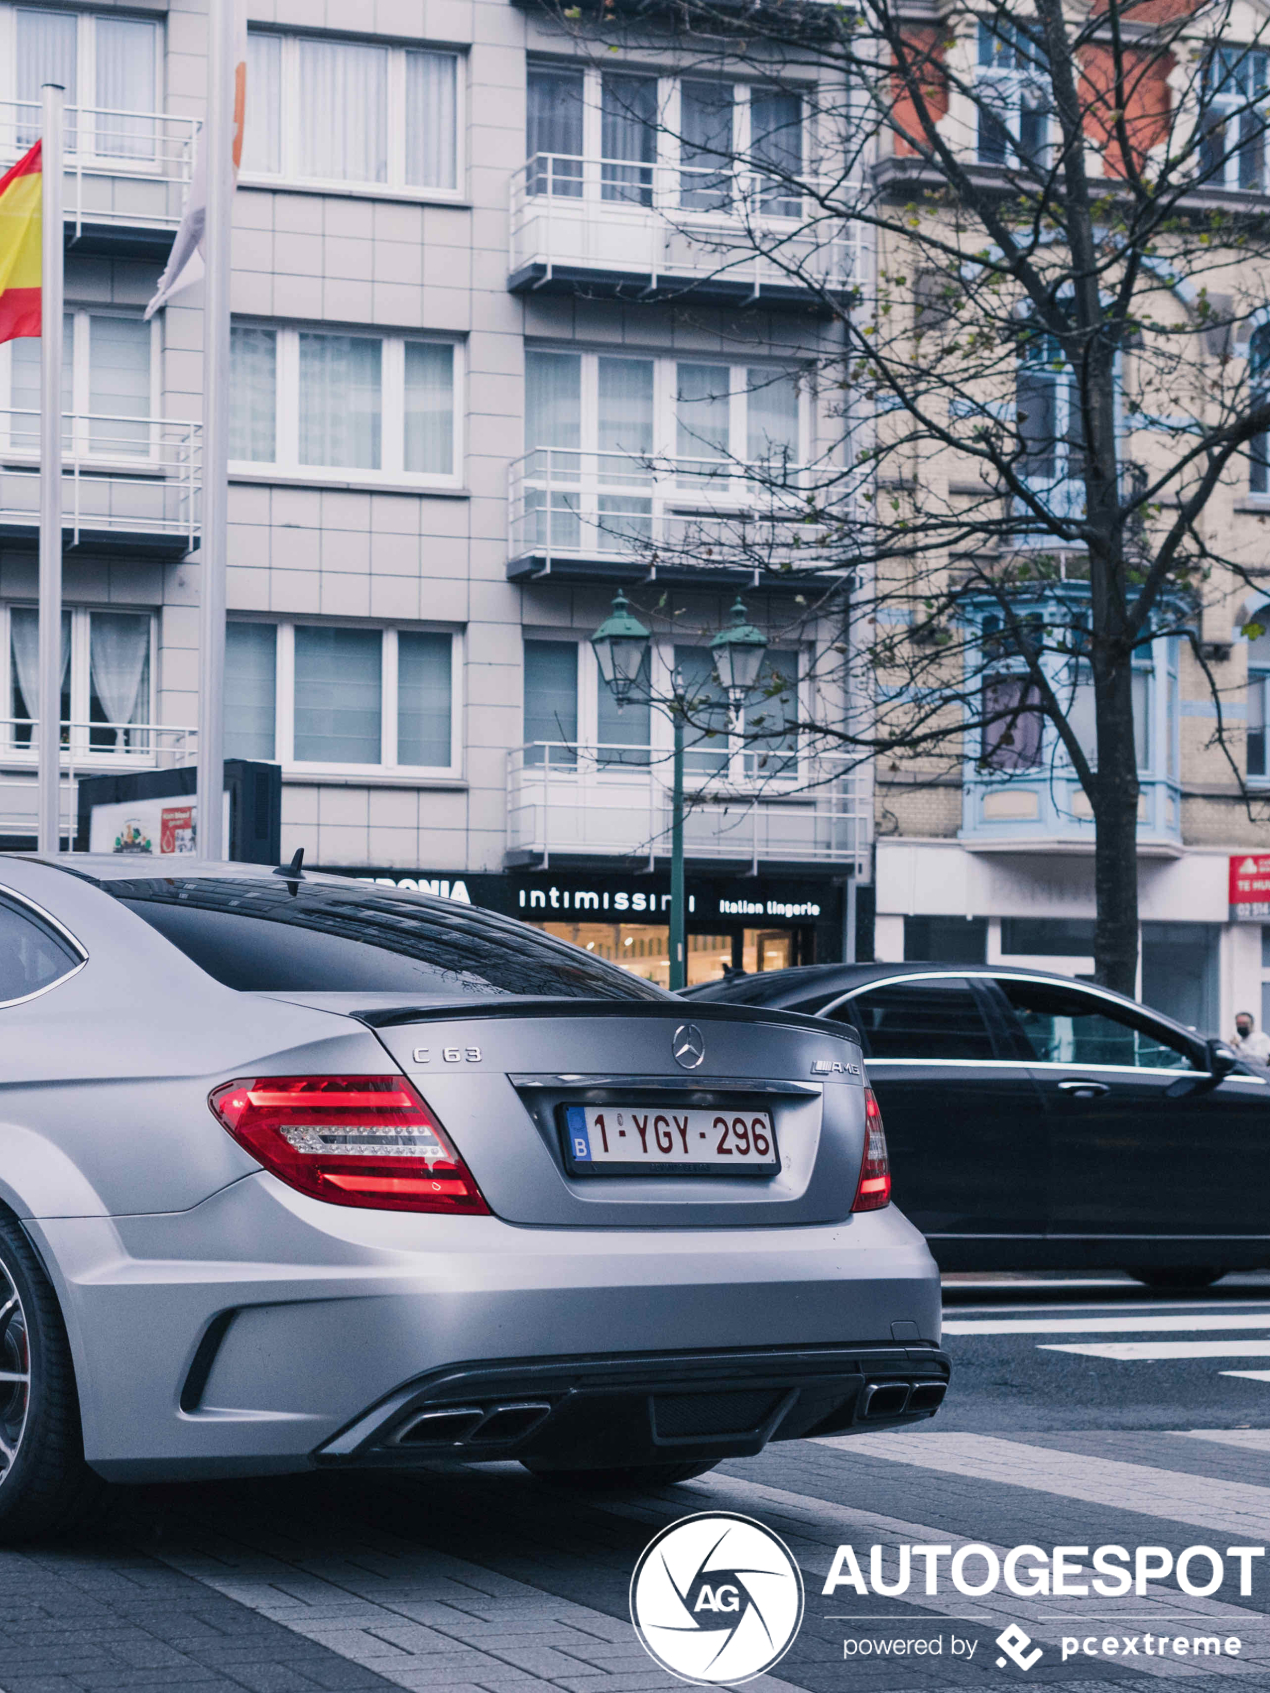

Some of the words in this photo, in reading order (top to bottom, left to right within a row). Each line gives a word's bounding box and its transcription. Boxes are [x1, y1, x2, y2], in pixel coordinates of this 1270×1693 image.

[720, 900, 764, 914] Italian
[767, 901, 820, 918] lingerie
[412, 1047, 430, 1063] C
[443, 1046, 482, 1063] 63
[574, 1138, 587, 1157] B
